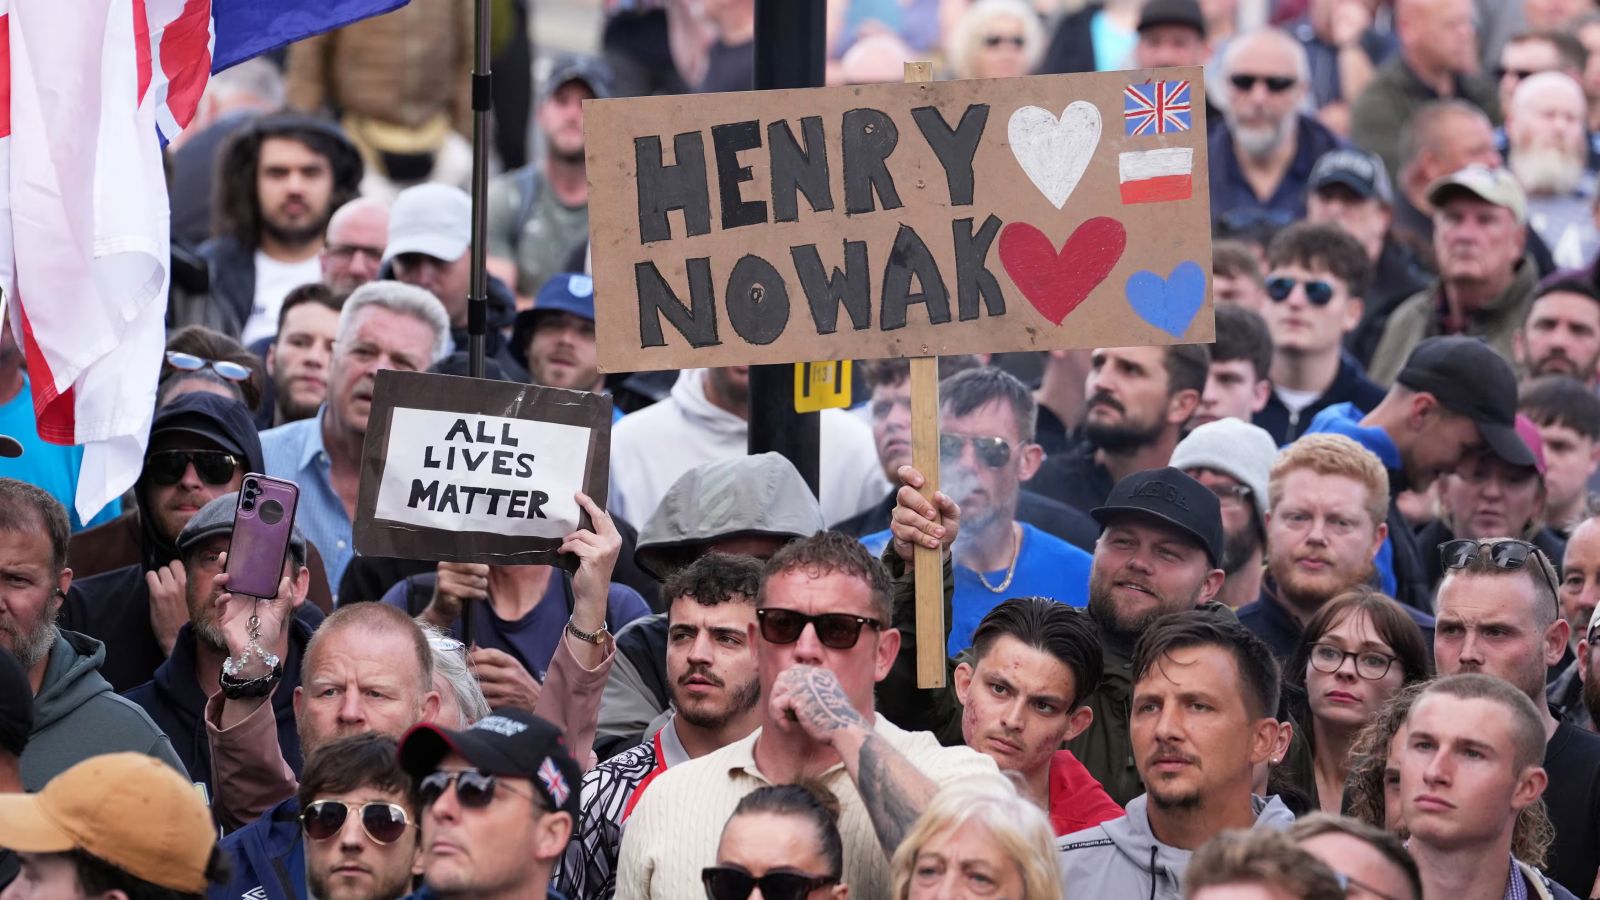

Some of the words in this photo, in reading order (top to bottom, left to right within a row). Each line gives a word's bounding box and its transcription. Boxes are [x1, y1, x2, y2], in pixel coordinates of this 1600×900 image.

[633, 103, 991, 246] HENRY
[633, 213, 1007, 350] NOWAK
[444, 418, 519, 448] ALL
[423, 445, 535, 479] LIVES
[406, 478, 550, 520] MATTER
